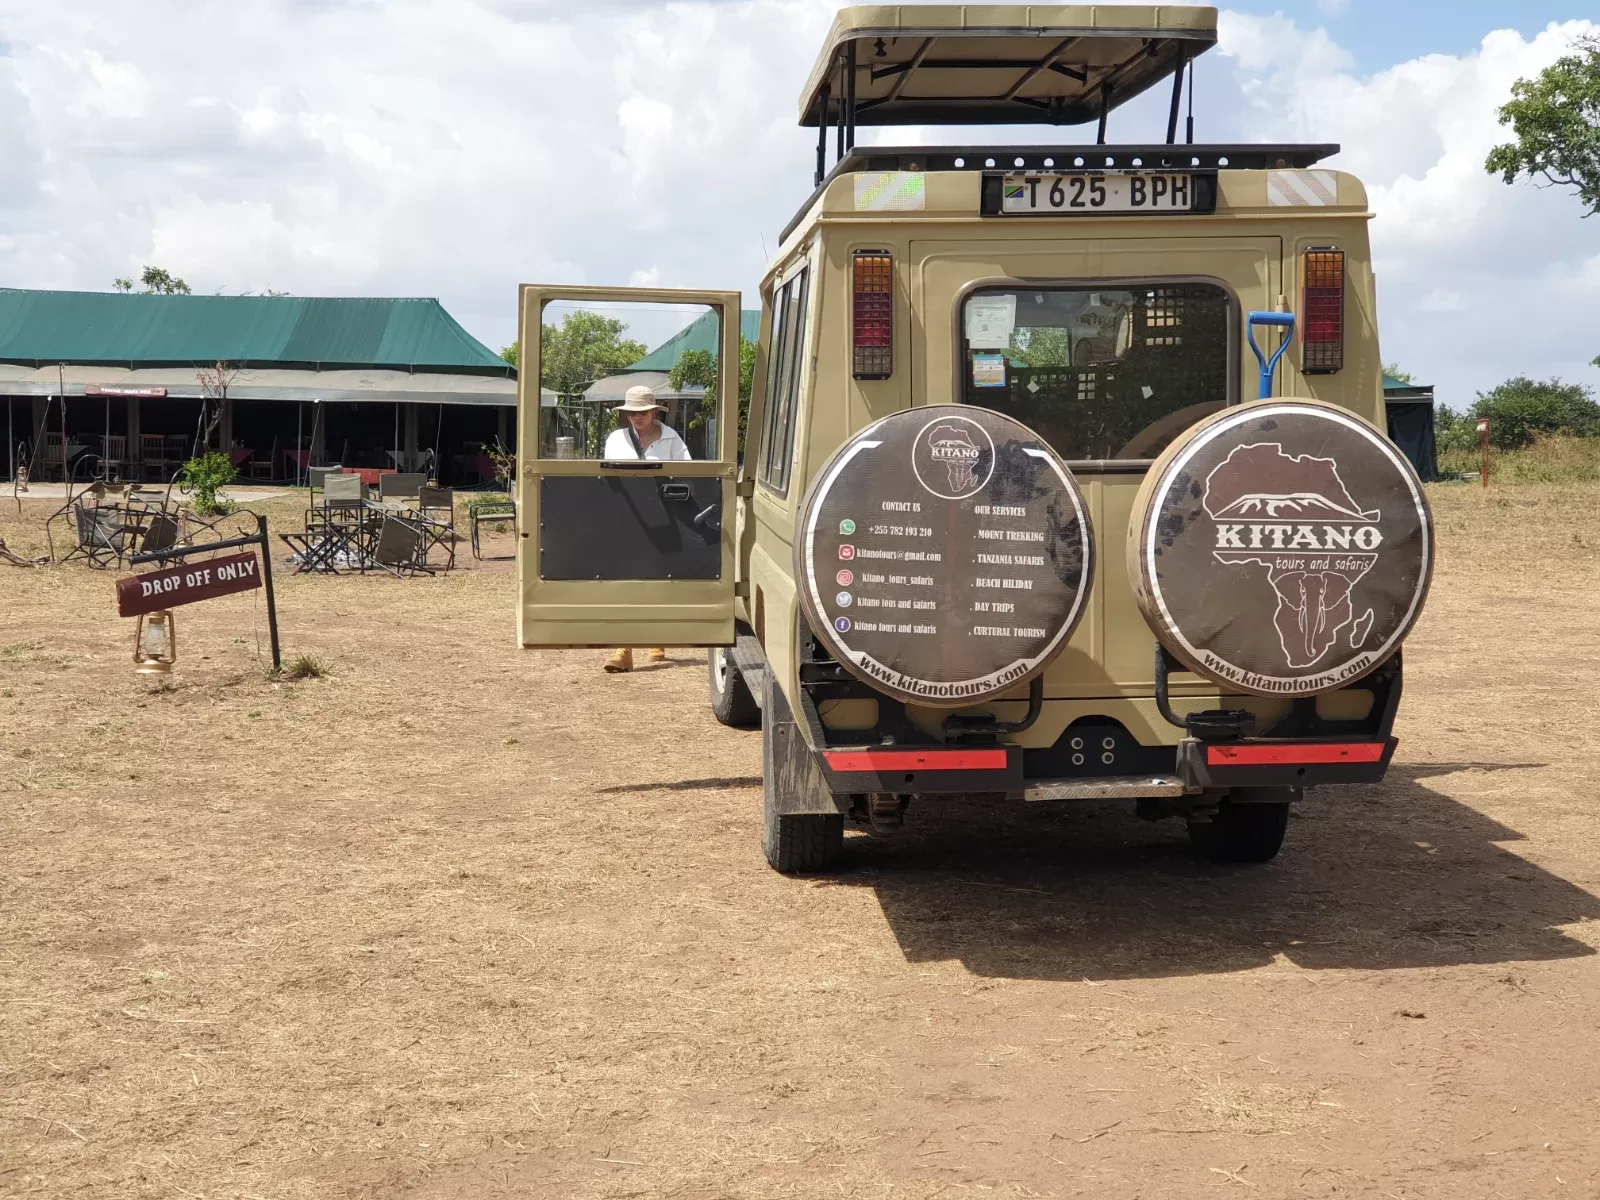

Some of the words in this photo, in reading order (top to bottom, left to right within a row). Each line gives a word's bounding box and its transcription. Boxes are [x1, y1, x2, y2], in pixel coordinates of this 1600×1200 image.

[1024, 177, 1042, 208] T
[1049, 177, 1106, 208] 625
[1130, 175, 1188, 207] BPH
[931, 447, 980, 458] KITANO
[882, 501, 911, 512] CONTACT
[912, 502, 921, 513] US
[974, 505, 991, 515] OUR
[992, 505, 1026, 517] SERVICES
[868, 525, 888, 535] +255
[889, 526, 903, 536] 782
[905, 526, 918, 537] 193
[919, 527, 933, 537] 210
[978, 529, 1005, 540] MOUNT
[1006, 530, 1044, 542] TREKKING
[1215, 524, 1384, 550] KITANO
[856, 548, 942, 562] kitanotours@gmail.com
[977, 553, 1012, 565] TANZANIA
[1014, 555, 1045, 566] SAFARIS
[1275, 556, 1305, 570] tours
[1310, 555, 1331, 570] and
[1334, 556, 1371, 571] safaris
[140, 575, 181, 598] DROP
[186, 568, 211, 588] OFF
[217, 560, 256, 581] ONLY
[975, 577, 1001, 588] BEACH
[1002, 578, 1034, 590] HILIDAY
[857, 596, 880, 608] kitano
[881, 598, 897, 608] tous
[897, 600, 912, 609] and
[912, 600, 937, 610] safaris
[974, 602, 991, 612] DAY
[991, 602, 1015, 613] TRIPS
[854, 621, 877, 632] kitano
[878, 622, 897, 633] tours
[898, 624, 912, 633] and
[913, 625, 937, 635] safaris
[973, 626, 1011, 637] CURTURAL
[1012, 627, 1046, 638] TOURISM
[859, 656, 1029, 697] www.kitanotours.com
[1204, 653, 1372, 692] www.kitanotours.com
